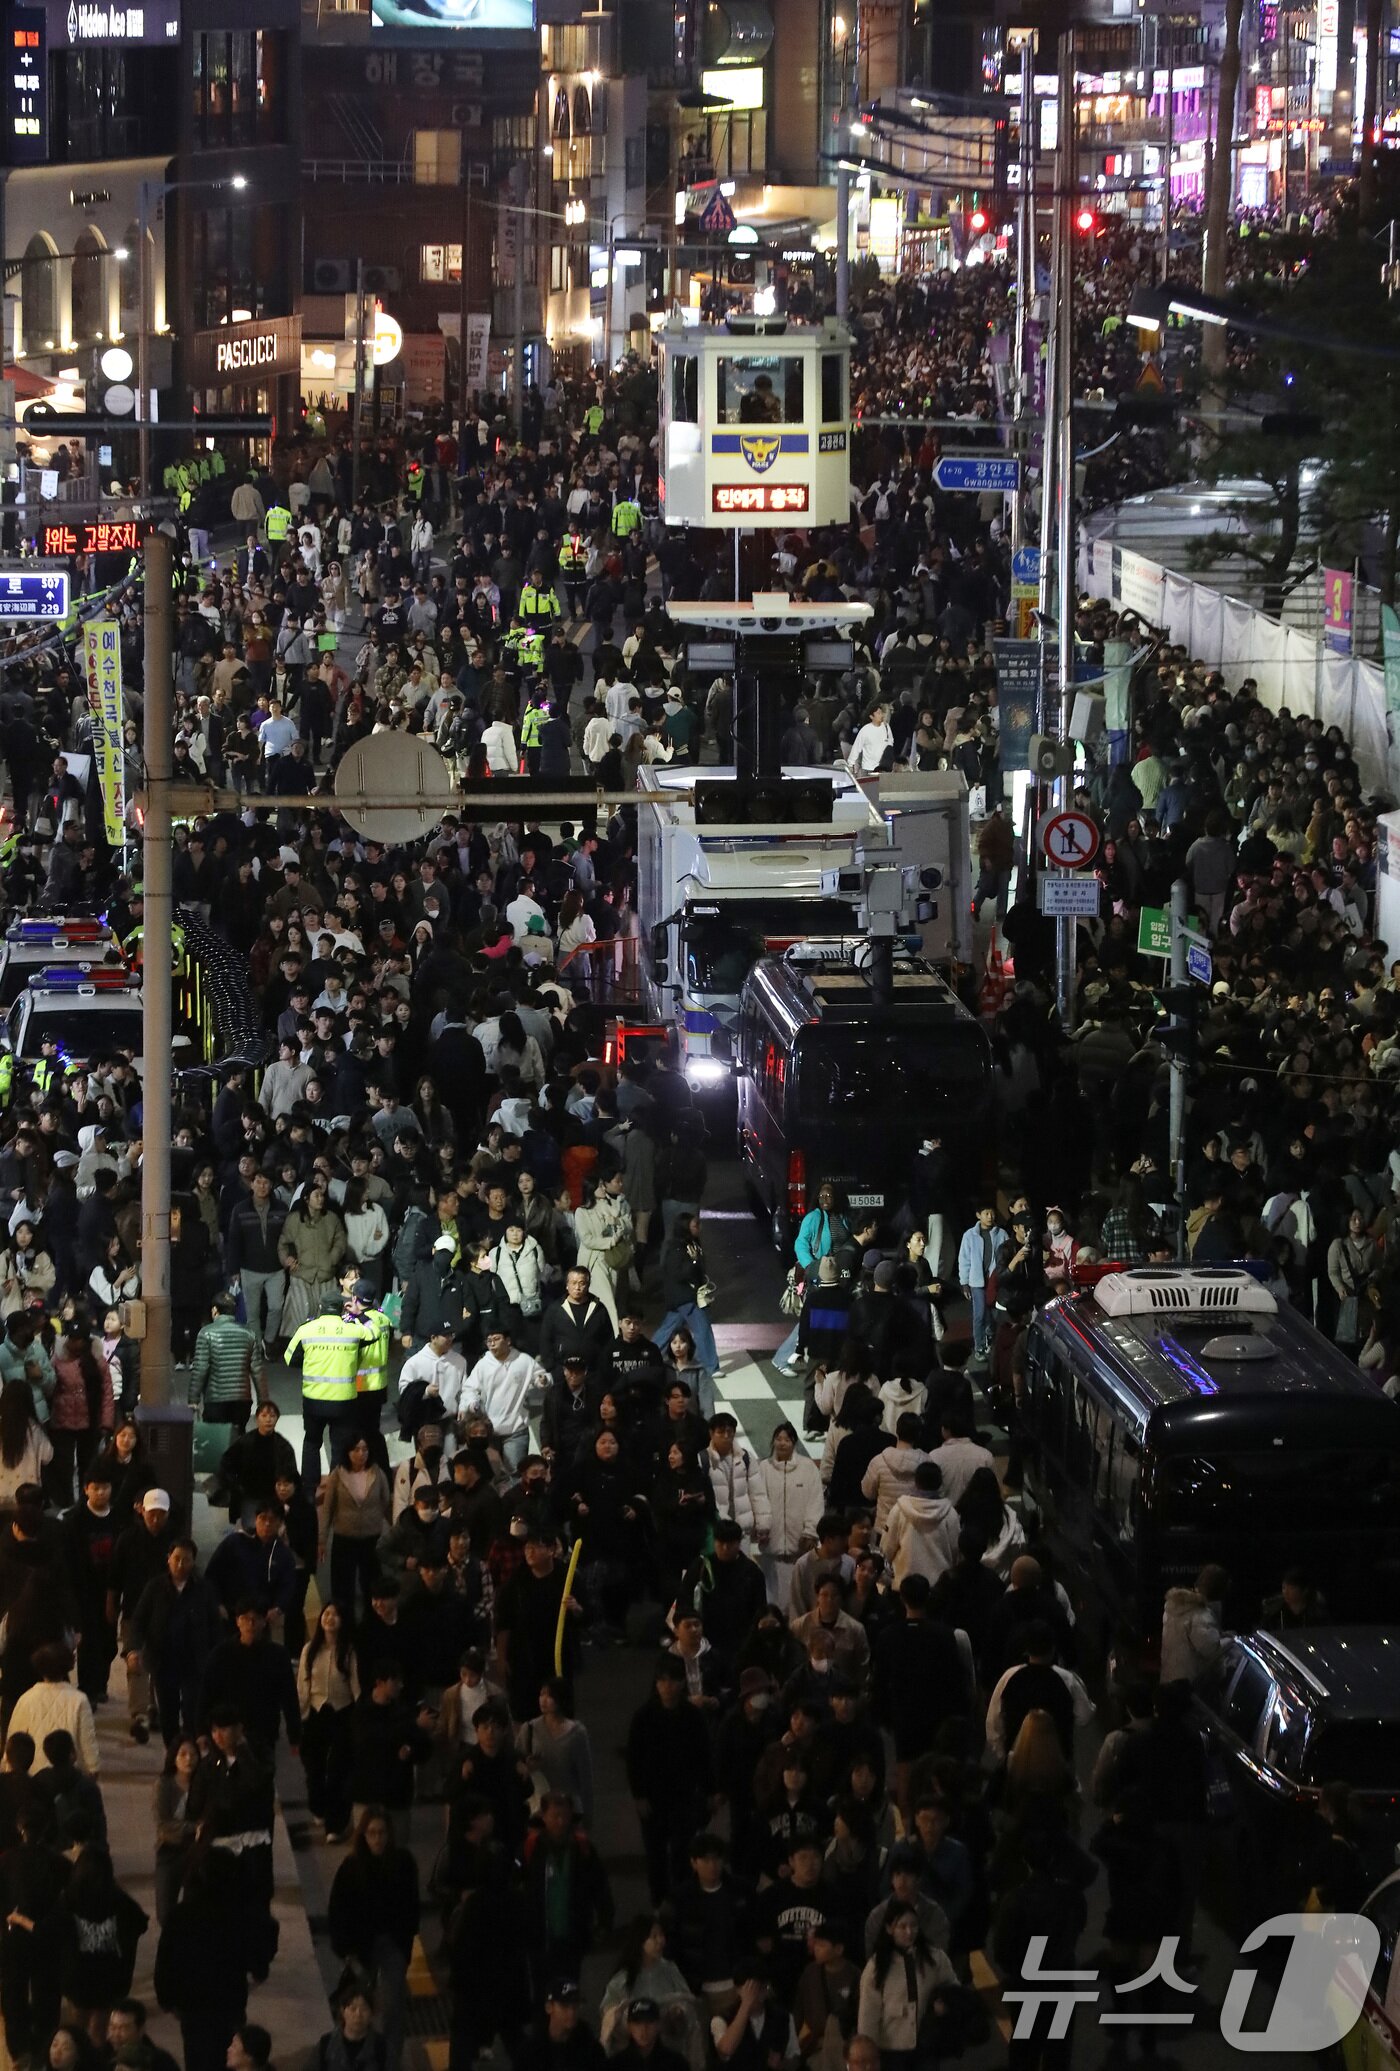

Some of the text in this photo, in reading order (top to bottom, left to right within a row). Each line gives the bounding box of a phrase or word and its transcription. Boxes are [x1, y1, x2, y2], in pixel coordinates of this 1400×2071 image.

[78, 4, 107, 38] Hidden
[108, 4, 125, 37] Ace
[365, 52, 486, 87] 해장국
[217, 333, 277, 372] PASCUCCI
[975, 462, 1015, 478] 광안로
[963, 477, 1015, 489] Gwangan-ro
[41, 577, 60, 589] 507
[1332, 578, 1342, 622] 3
[40, 604, 60, 614] 229
[1150, 934, 1172, 948] 입구
[312, 1344, 350, 1352] POLICE
